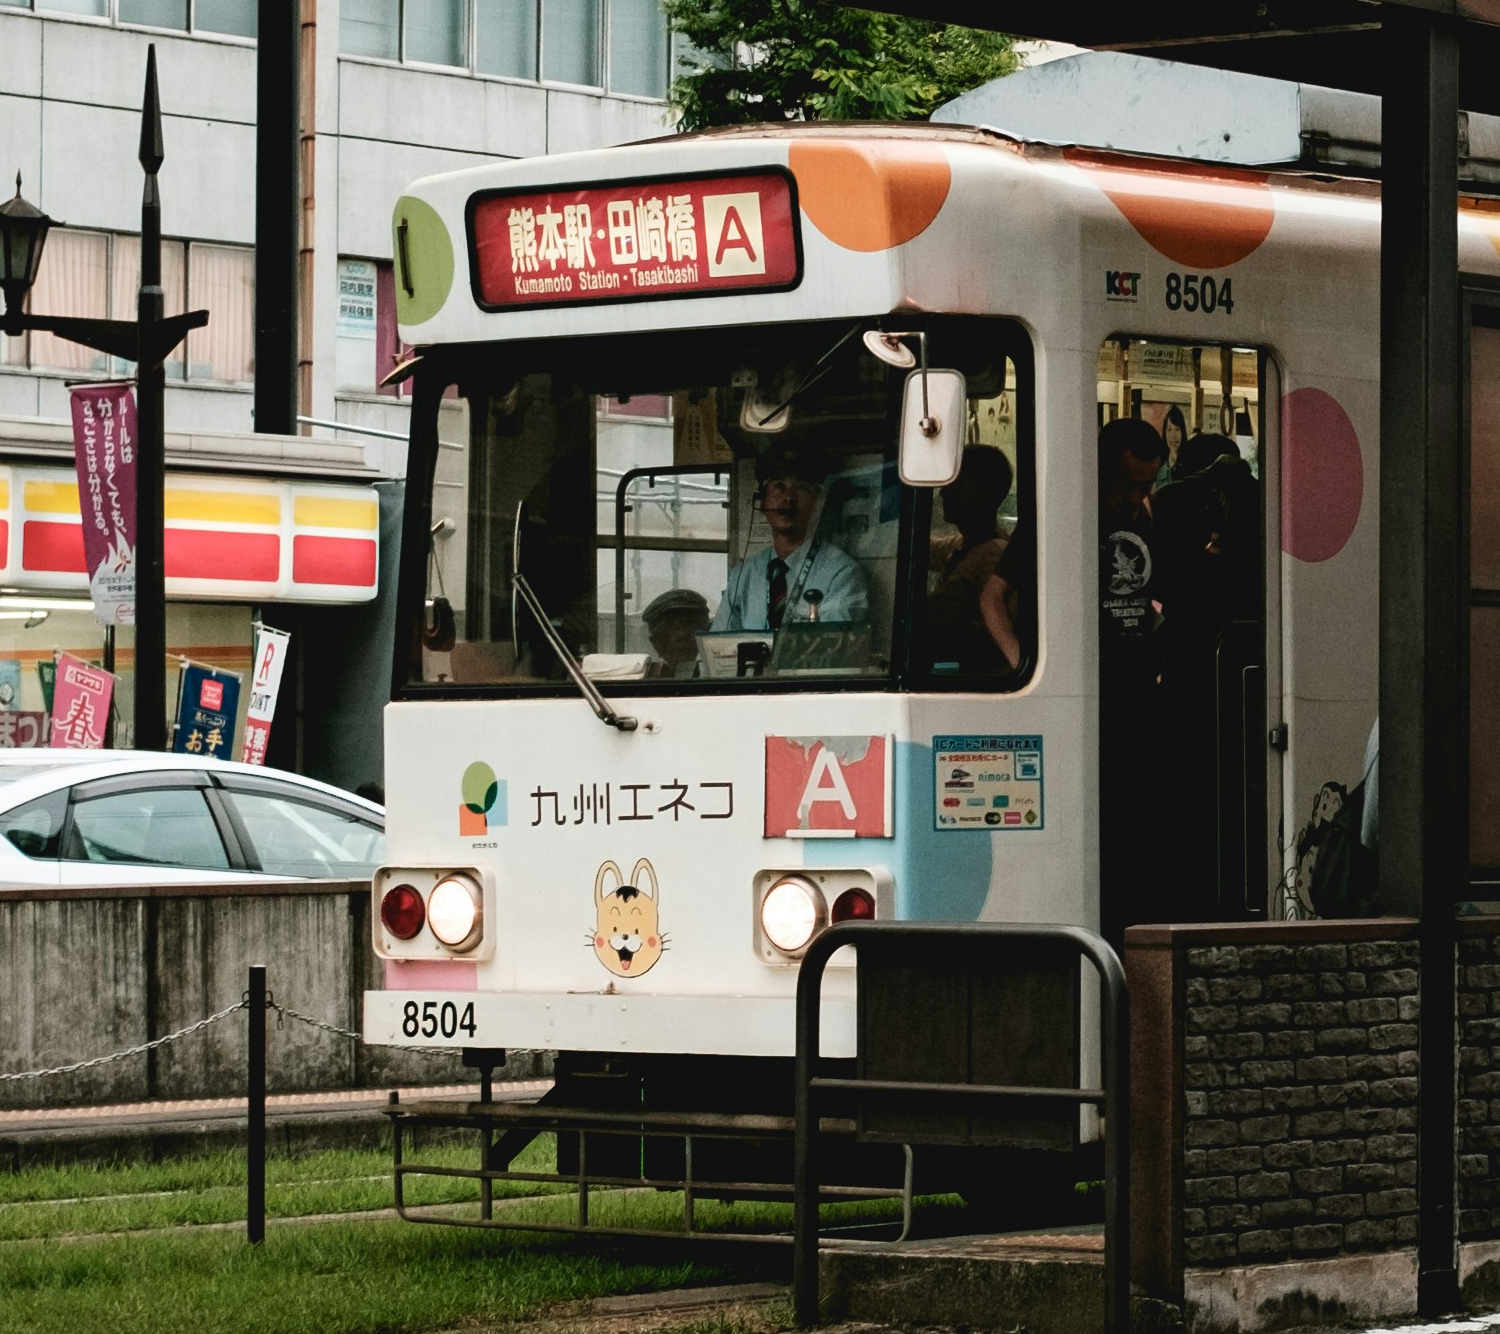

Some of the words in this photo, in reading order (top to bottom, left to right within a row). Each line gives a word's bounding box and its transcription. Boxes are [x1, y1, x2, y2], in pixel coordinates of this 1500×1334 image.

[507, 193, 698, 275] 熊本駅・田崎橋
[715, 206, 757, 265] A
[514, 274, 572, 297] Kumamoto
[579, 268, 620, 292] Station
[630, 265, 699, 289] Tasakibashi
[1105, 270, 1142, 297] KCT
[1165, 271, 1235, 315] 8504
[118, 397, 133, 464] ルールは
[81, 398, 110, 536] すごさは分かる。
[97, 398, 128, 534] 分からなくても、
[530, 777, 734, 828] 九州エネコ
[800, 746, 856, 821] A
[401, 1000, 478, 1040] 8504
